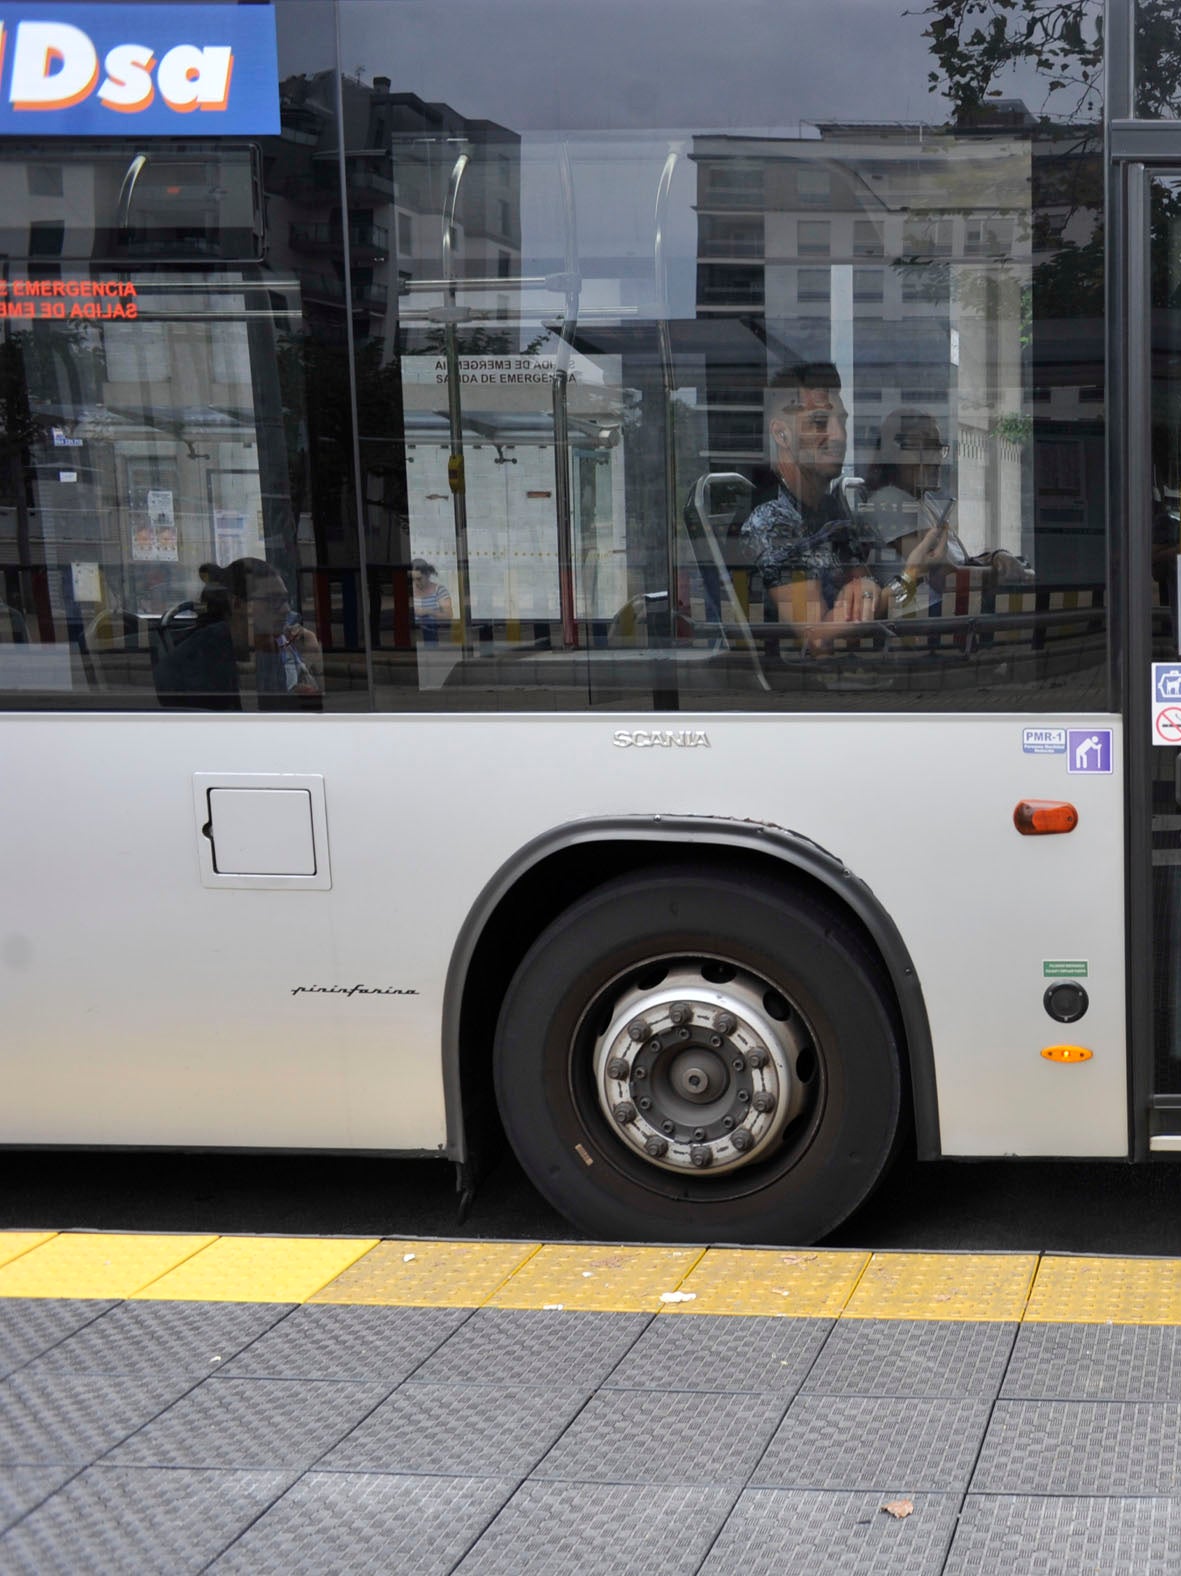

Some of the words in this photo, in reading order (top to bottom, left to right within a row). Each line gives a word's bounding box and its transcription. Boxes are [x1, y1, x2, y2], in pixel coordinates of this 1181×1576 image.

[0, 20, 234, 113] Dsa
[13, 280, 137, 297] EMERGENCIA
[481, 374, 497, 383] DE
[613, 730, 711, 748] SCANIA
[1026, 731, 1062, 742] PMR-1
[291, 984, 420, 997] pininfarina
